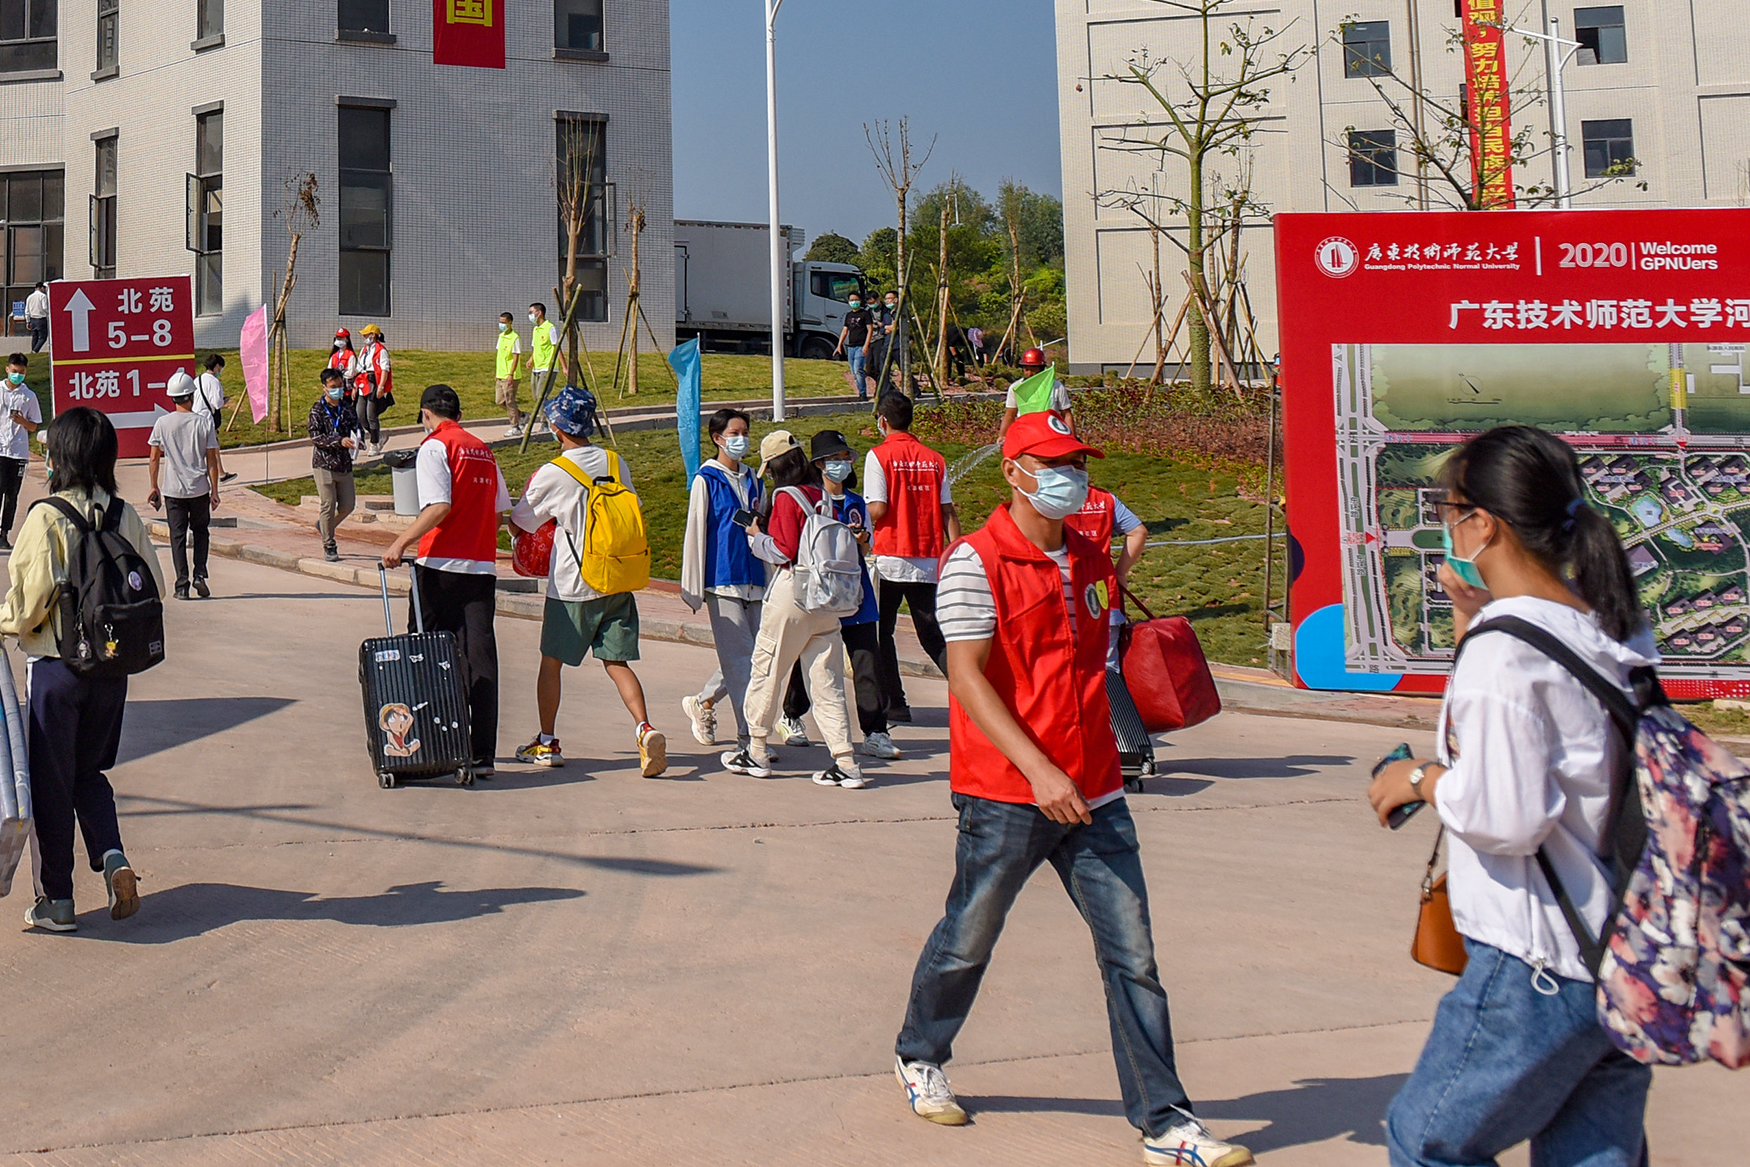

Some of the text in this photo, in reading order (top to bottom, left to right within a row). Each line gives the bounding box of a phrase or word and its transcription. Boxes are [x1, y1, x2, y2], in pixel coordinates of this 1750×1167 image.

[1558, 242, 1628, 268] 2020
[1640, 241, 1718, 255] Welcome
[1364, 263, 1406, 271] Guangdong
[1407, 263, 1451, 271] Polytechnic
[1482, 263, 1520, 271] University
[1640, 257, 1719, 270] GPNUers
[117, 287, 174, 314] 北苑
